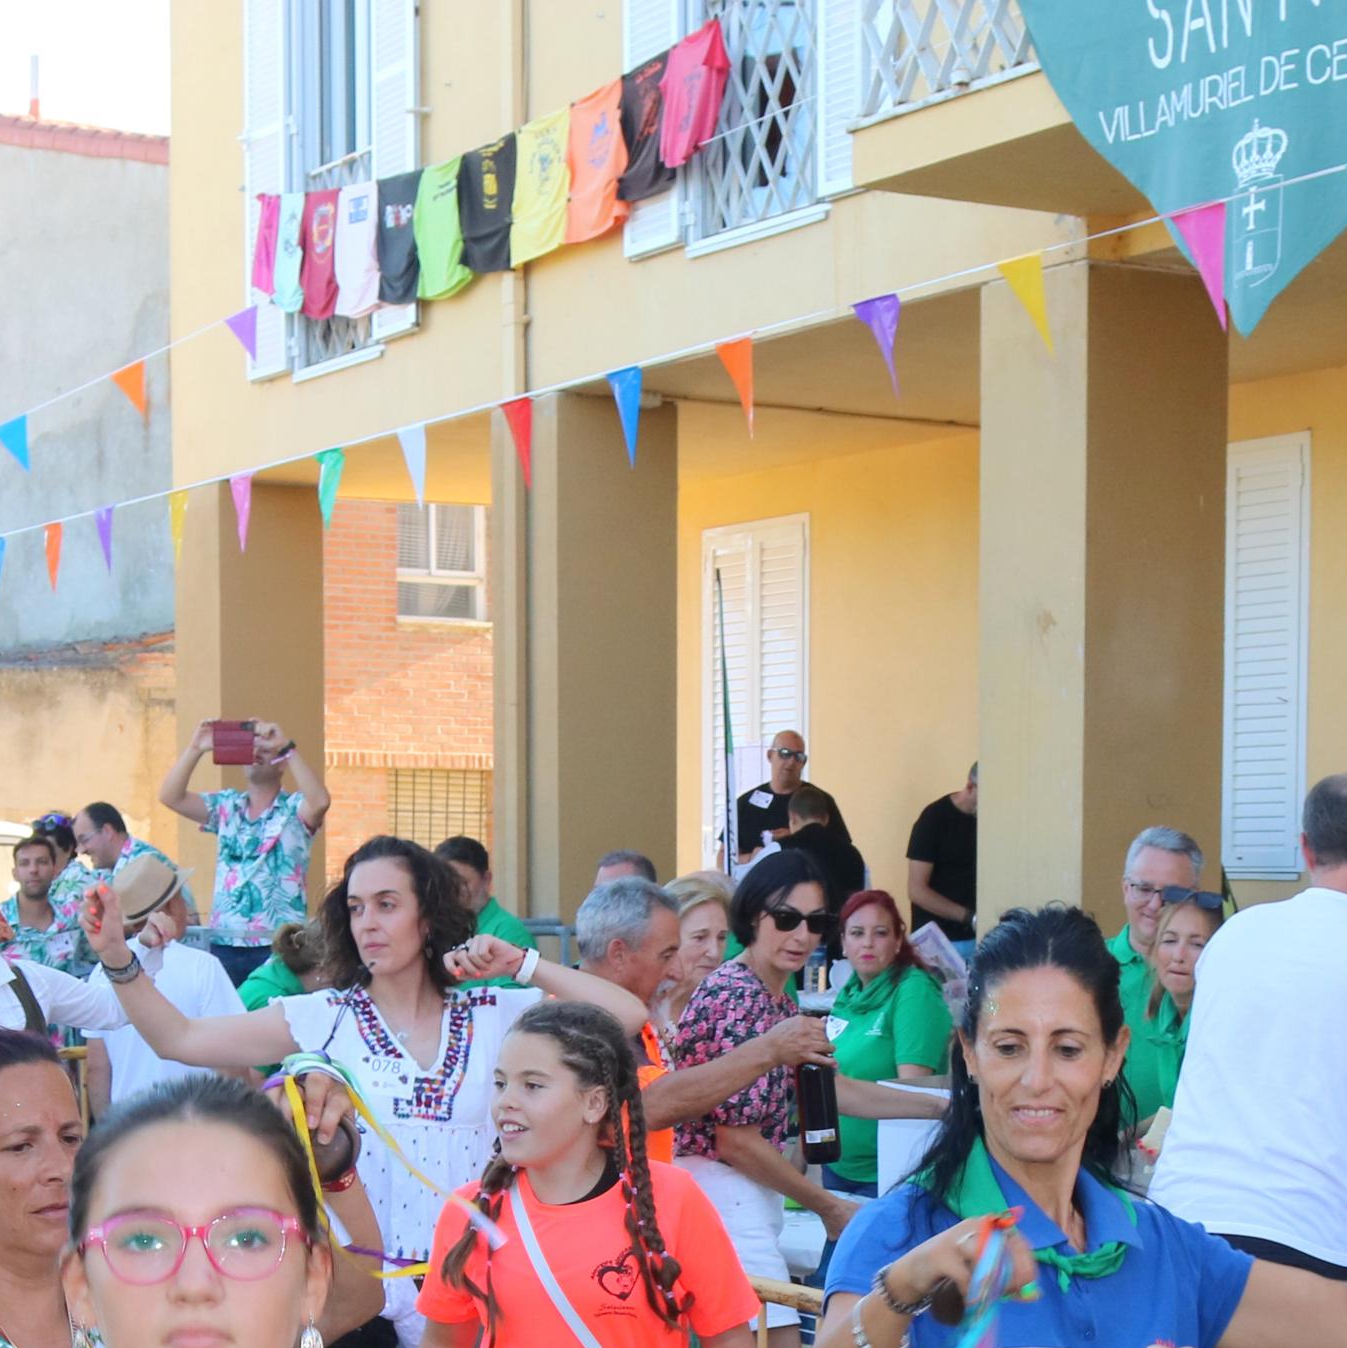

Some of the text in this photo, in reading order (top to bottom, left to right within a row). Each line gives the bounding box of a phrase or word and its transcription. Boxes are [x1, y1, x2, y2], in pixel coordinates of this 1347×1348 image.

[1098, 65, 1254, 145] VILLAMURIEL
[1259, 48, 1300, 97] DE
[371, 1058, 401, 1074] 078
